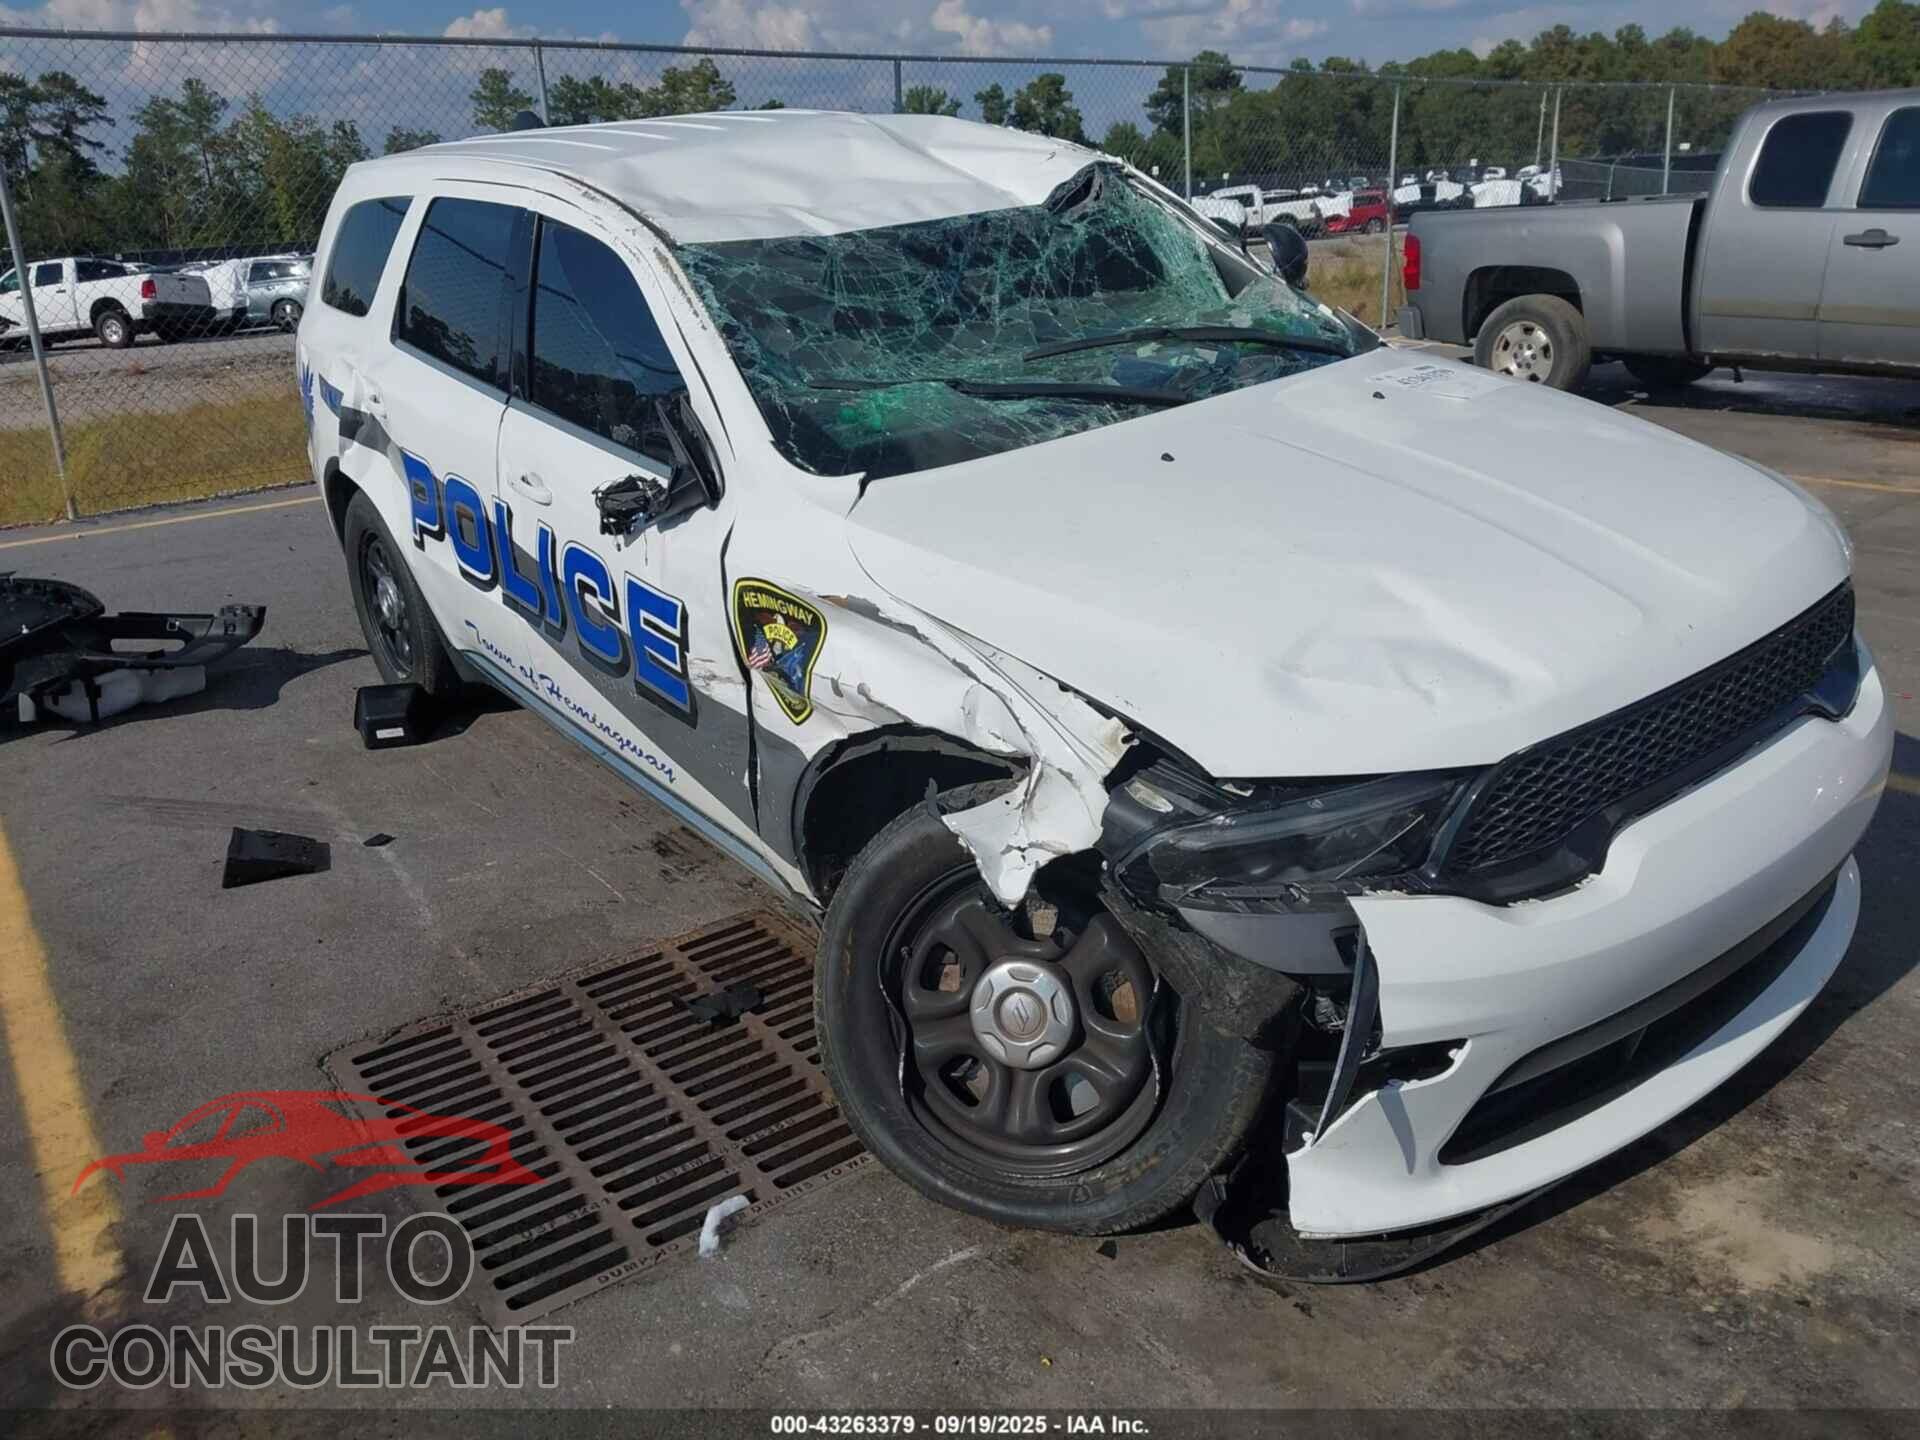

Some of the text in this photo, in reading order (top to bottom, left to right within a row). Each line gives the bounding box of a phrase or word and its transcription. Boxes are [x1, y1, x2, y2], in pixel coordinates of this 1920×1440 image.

[401, 447, 697, 729] POLICE
[743, 591, 814, 625] HEMINGWAY
[767, 624, 796, 648] POLICE
[464, 619, 516, 669] Town
[538, 673, 676, 783] Hemingway
